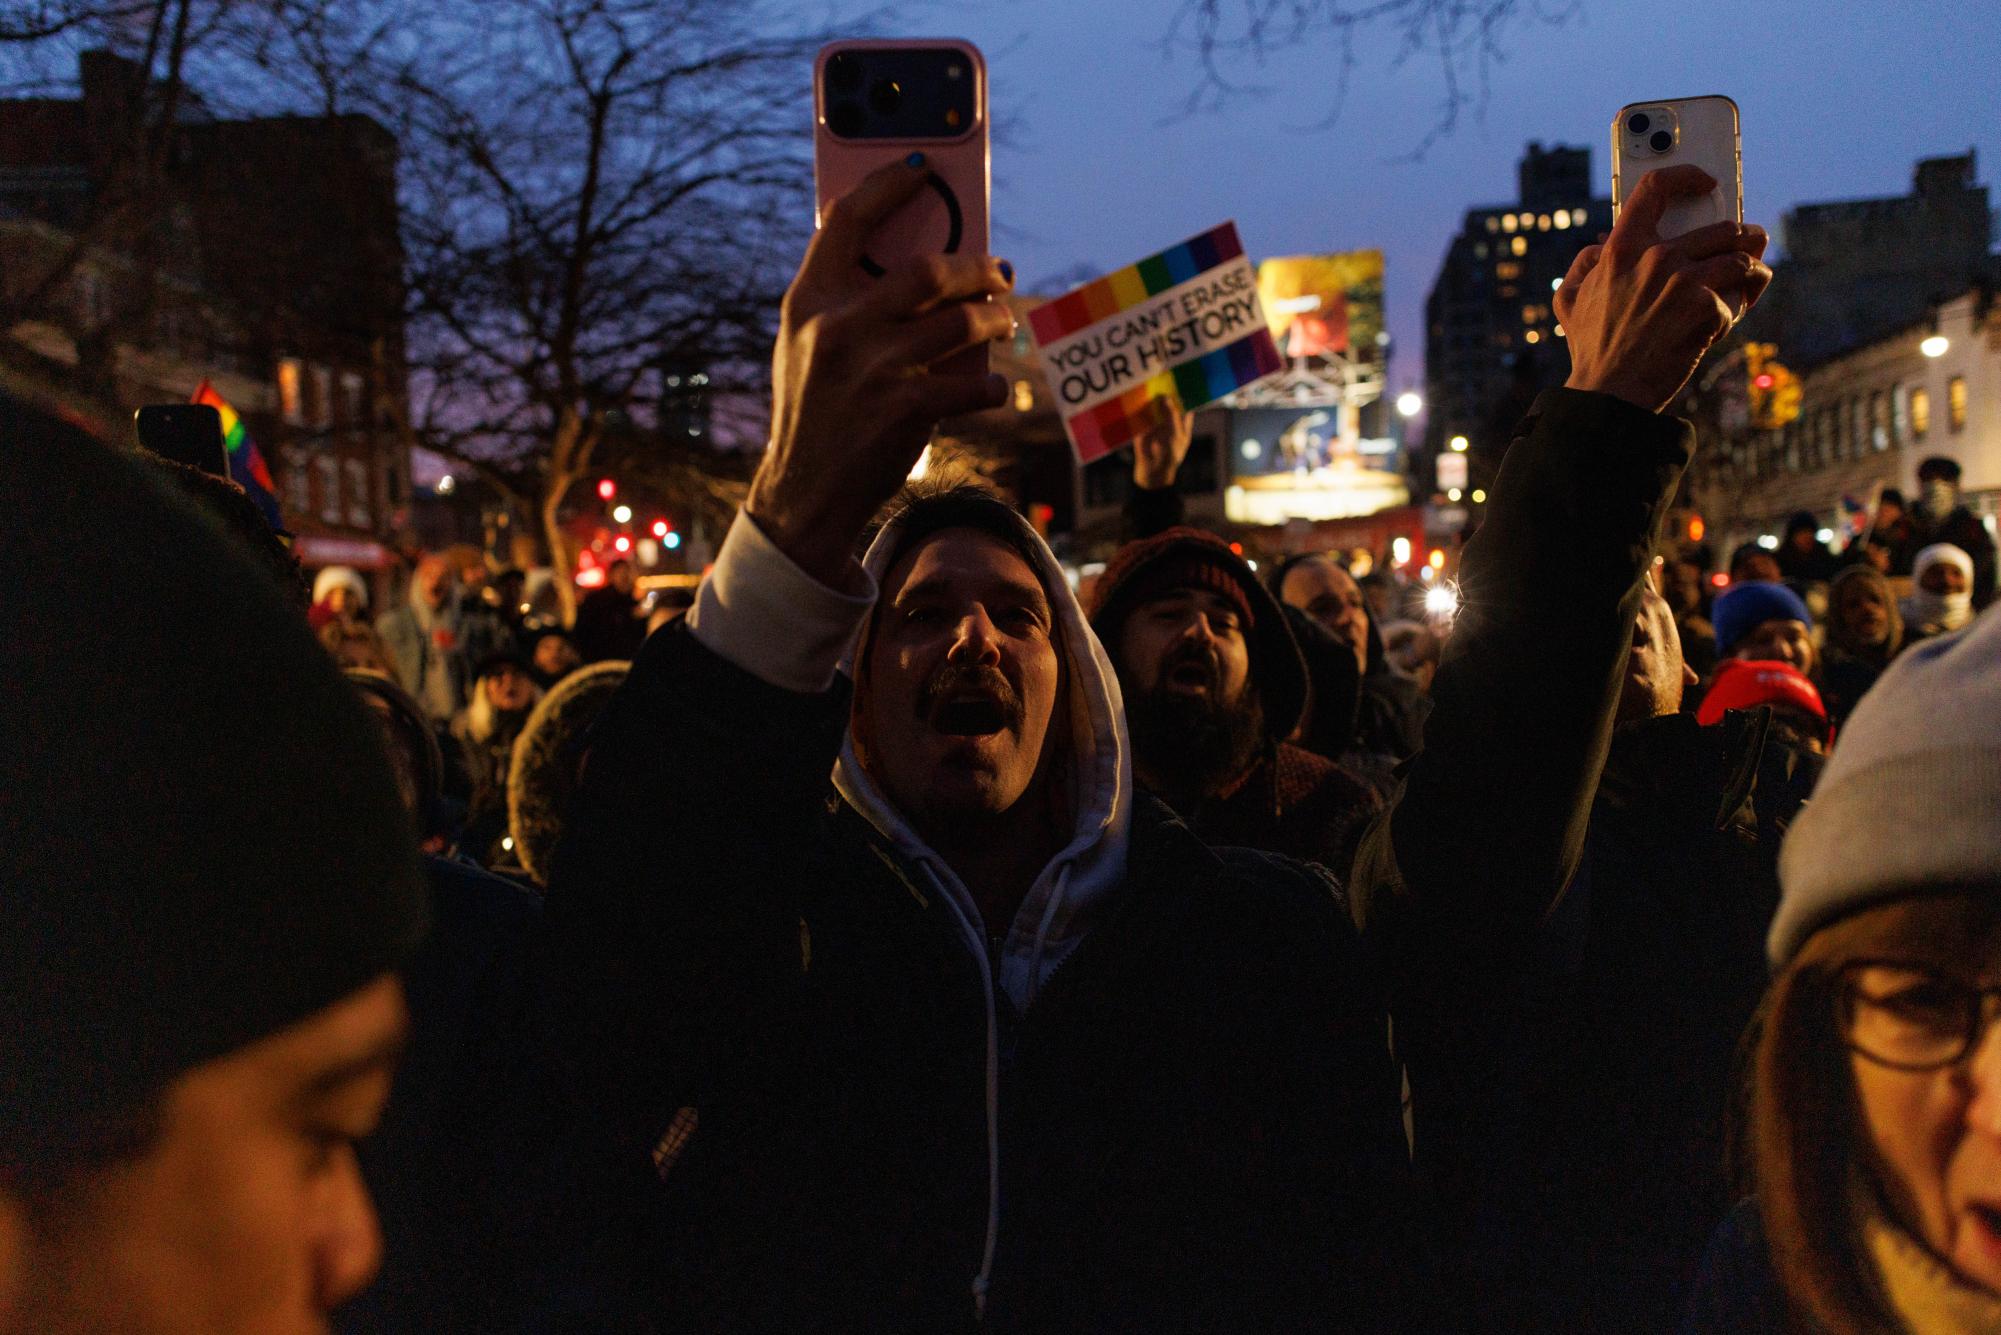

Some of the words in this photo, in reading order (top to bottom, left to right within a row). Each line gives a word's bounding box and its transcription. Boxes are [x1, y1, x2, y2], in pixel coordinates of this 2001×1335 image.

[1049, 336, 1103, 371] YOU
[1106, 303, 1175, 348] CAN'T
[1181, 267, 1249, 315] ERASE
[1061, 354, 1133, 403] OUR
[1138, 291, 1256, 370] HISTORY
